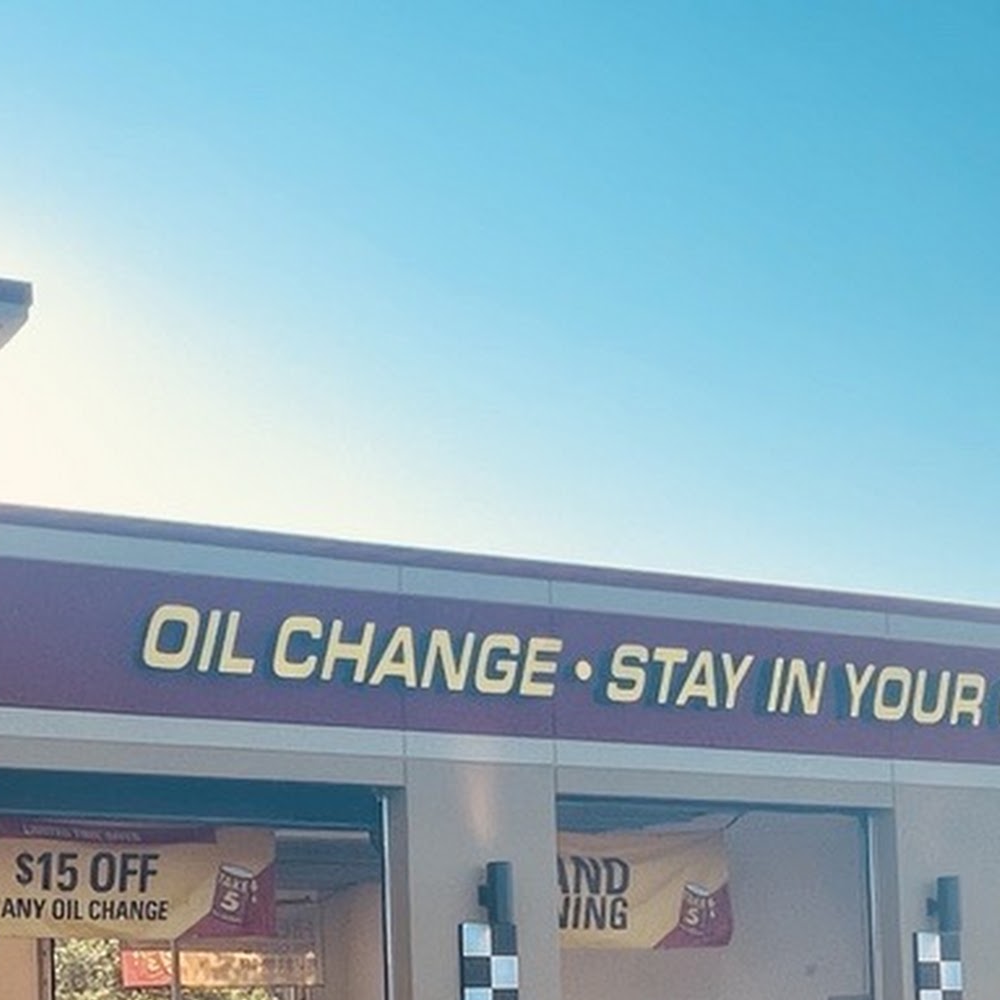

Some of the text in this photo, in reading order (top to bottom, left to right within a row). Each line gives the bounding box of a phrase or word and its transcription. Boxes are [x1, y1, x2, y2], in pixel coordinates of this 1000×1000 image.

[142, 603, 987, 726] OIL CHANGE STAY IN YOUR
[15, 851, 159, 893] $15 OFF
[1, 898, 168, 921] ANY OIL CHANGE
[220, 891, 240, 911] 5
